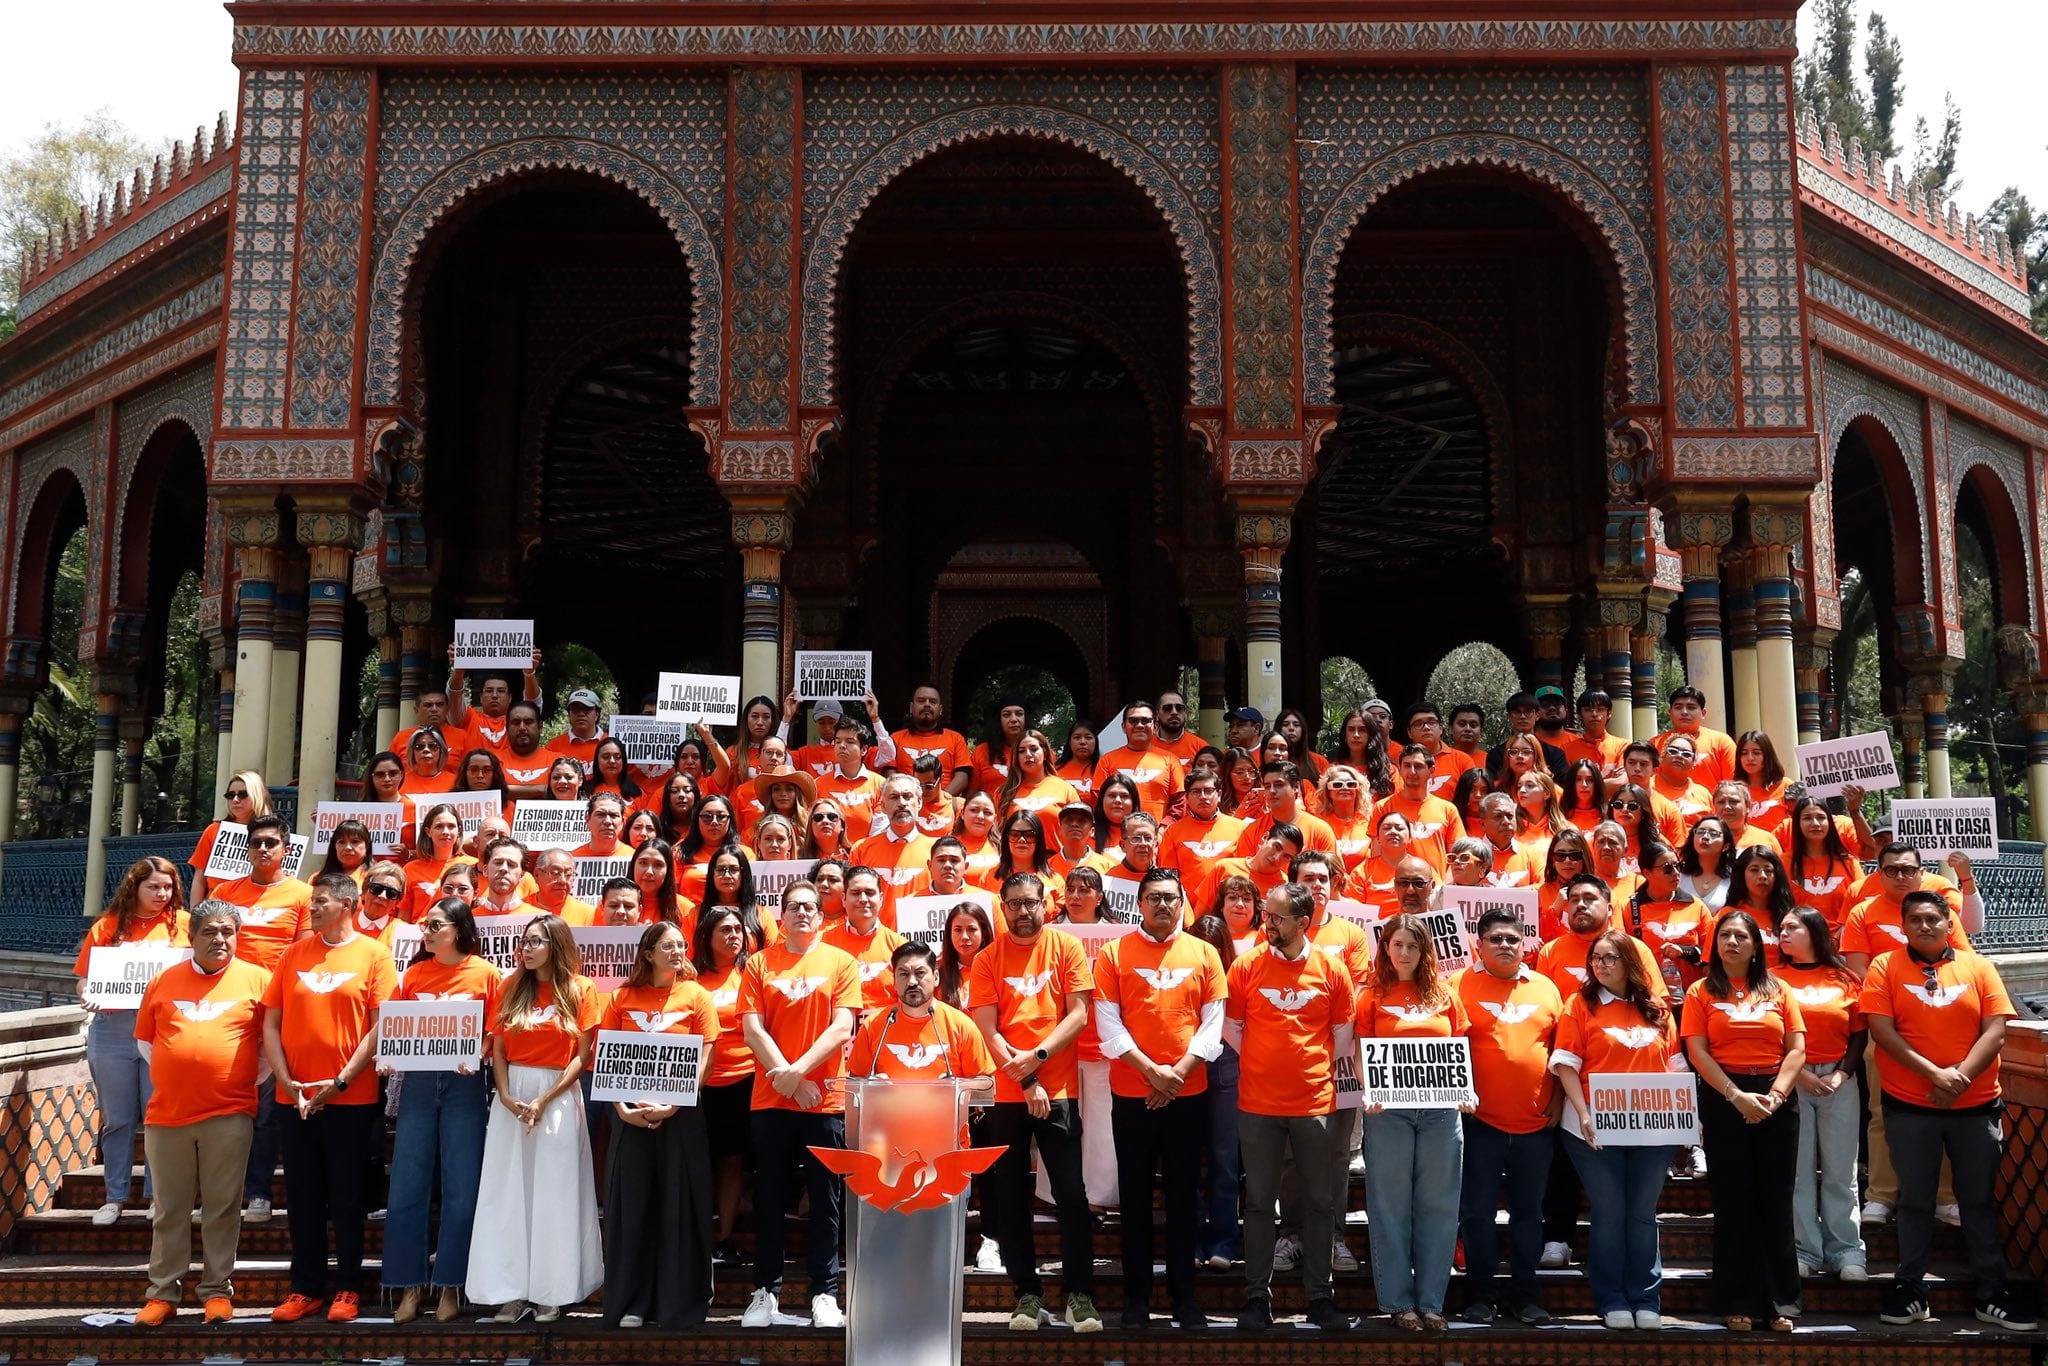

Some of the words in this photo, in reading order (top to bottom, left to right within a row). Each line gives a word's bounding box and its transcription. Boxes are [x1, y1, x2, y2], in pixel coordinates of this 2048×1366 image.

[457, 632, 467, 647] V.
[470, 632, 531, 647] CARRANZA
[456, 647, 465, 658] 30
[488, 647, 497, 658] DE
[499, 647, 531, 658] TANDEOS
[800, 669, 824, 680] 8,400
[825, 669, 866, 679] ALBERCAS
[659, 700, 668, 710] 30
[692, 702, 701, 712] DE
[703, 702, 736, 714] TANDEOS
[615, 733, 638, 743] 8400
[639, 733, 680, 744] ALBERCAS
[627, 744, 679, 760] IMPICAS
[1805, 745, 1885, 775] IZTACALCO
[1805, 775, 1817, 787] 30
[1842, 769, 1854, 782] DE
[1854, 763, 1894, 780] TANDEOS
[516, 809, 522, 820] 7
[523, 809, 563, 820] ESTADIOS
[564, 809, 589, 821] AZTEC
[1896, 808, 1927, 818] LLUVIAS
[1928, 808, 1954, 818] TODOS
[1955, 807, 1970, 817] LOS
[514, 821, 543, 832] LLENOS
[545, 821, 561, 832] CON
[563, 821, 570, 831] EL
[573, 821, 591, 832] AGU
[1898, 818, 1933, 835] AGUA
[1936, 818, 1952, 835] EN
[1955, 817, 1991, 835] CASA
[217, 830, 229, 844] 21
[383, 831, 396, 844] NO
[513, 832, 527, 842] QUE
[530, 832, 539, 842] SE
[1940, 836, 1947, 849] X
[1948, 836, 1992, 849] SEMANA
[214, 844, 226, 857] DE
[581, 860, 630, 877] MILLON
[769, 894, 779, 906] DE
[487, 925, 512, 936] TODOS
[494, 936, 509, 954] EN
[577, 943, 640, 963] CARRAN
[496, 955, 503, 968] X
[599, 964, 610, 977] DE
[90, 982, 102, 994] 30
[382, 1016, 414, 1038] CON
[417, 1015, 458, 1038] AGUA
[381, 1040, 411, 1056] BAJO
[414, 1040, 425, 1055] EL
[427, 1039, 458, 1055] AGUA
[460, 1039, 475, 1055] NO
[598, 1042, 605, 1058] 7
[606, 1043, 657, 1060] ESTADIOS
[659, 1046, 698, 1063] AZTECA
[1366, 1043, 1389, 1064] 2.7
[1392, 1043, 1466, 1064] MILLONES
[596, 1059, 632, 1075] LLENOS
[635, 1061, 656, 1077] CON
[657, 1062, 667, 1077] EL
[669, 1063, 697, 1079] AGUA
[1368, 1066, 1390, 1088] DE
[1392, 1065, 1468, 1088] HOGARES
[595, 1075, 614, 1089] QUE
[616, 1076, 629, 1090] SE
[630, 1077, 695, 1093] DESPERDICIA
[1371, 1090, 1391, 1103] CON
[1392, 1090, 1418, 1102] AGUA
[1420, 1090, 1431, 1102] EN
[1432, 1089, 1472, 1102] TANDAS.
[1594, 1089, 1627, 1112] CON
[1631, 1088, 1673, 1111] AGUA
[1596, 1113, 1627, 1130] BAJO
[1629, 1113, 1642, 1129] EL
[1644, 1113, 1675, 1129] AGUA
[1677, 1112, 1694, 1130] NO
